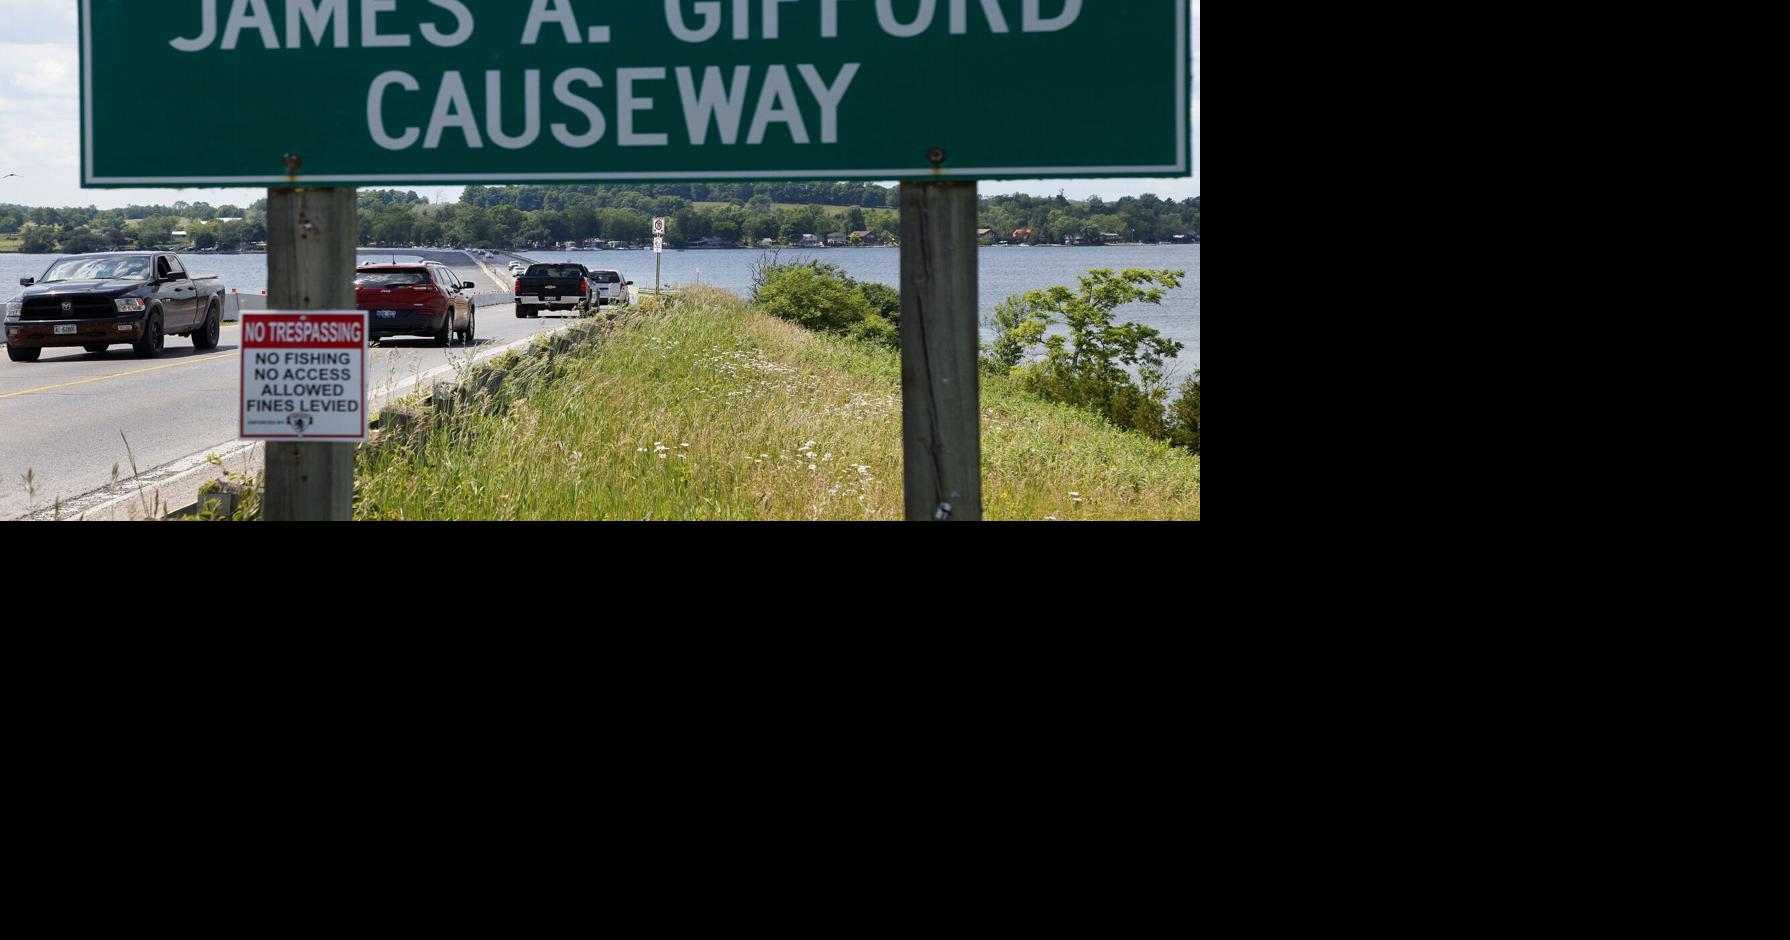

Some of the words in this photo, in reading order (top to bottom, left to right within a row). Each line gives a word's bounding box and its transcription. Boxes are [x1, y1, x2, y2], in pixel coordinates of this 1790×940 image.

[170, 0, 474, 51] JAMES
[522, 0, 609, 44] A.
[367, 64, 860, 150] CAUSEWAY
[245, 321, 265, 342] NO
[268, 321, 361, 342] TRESPASSING
[255, 352, 279, 365] NO
[284, 352, 350, 365] FISHING
[254, 368, 279, 381] NO
[283, 368, 351, 381] ACCESS
[261, 384, 344, 397] ALLOWED
[246, 400, 294, 412] FINES
[300, 400, 358, 412] LEVIED
